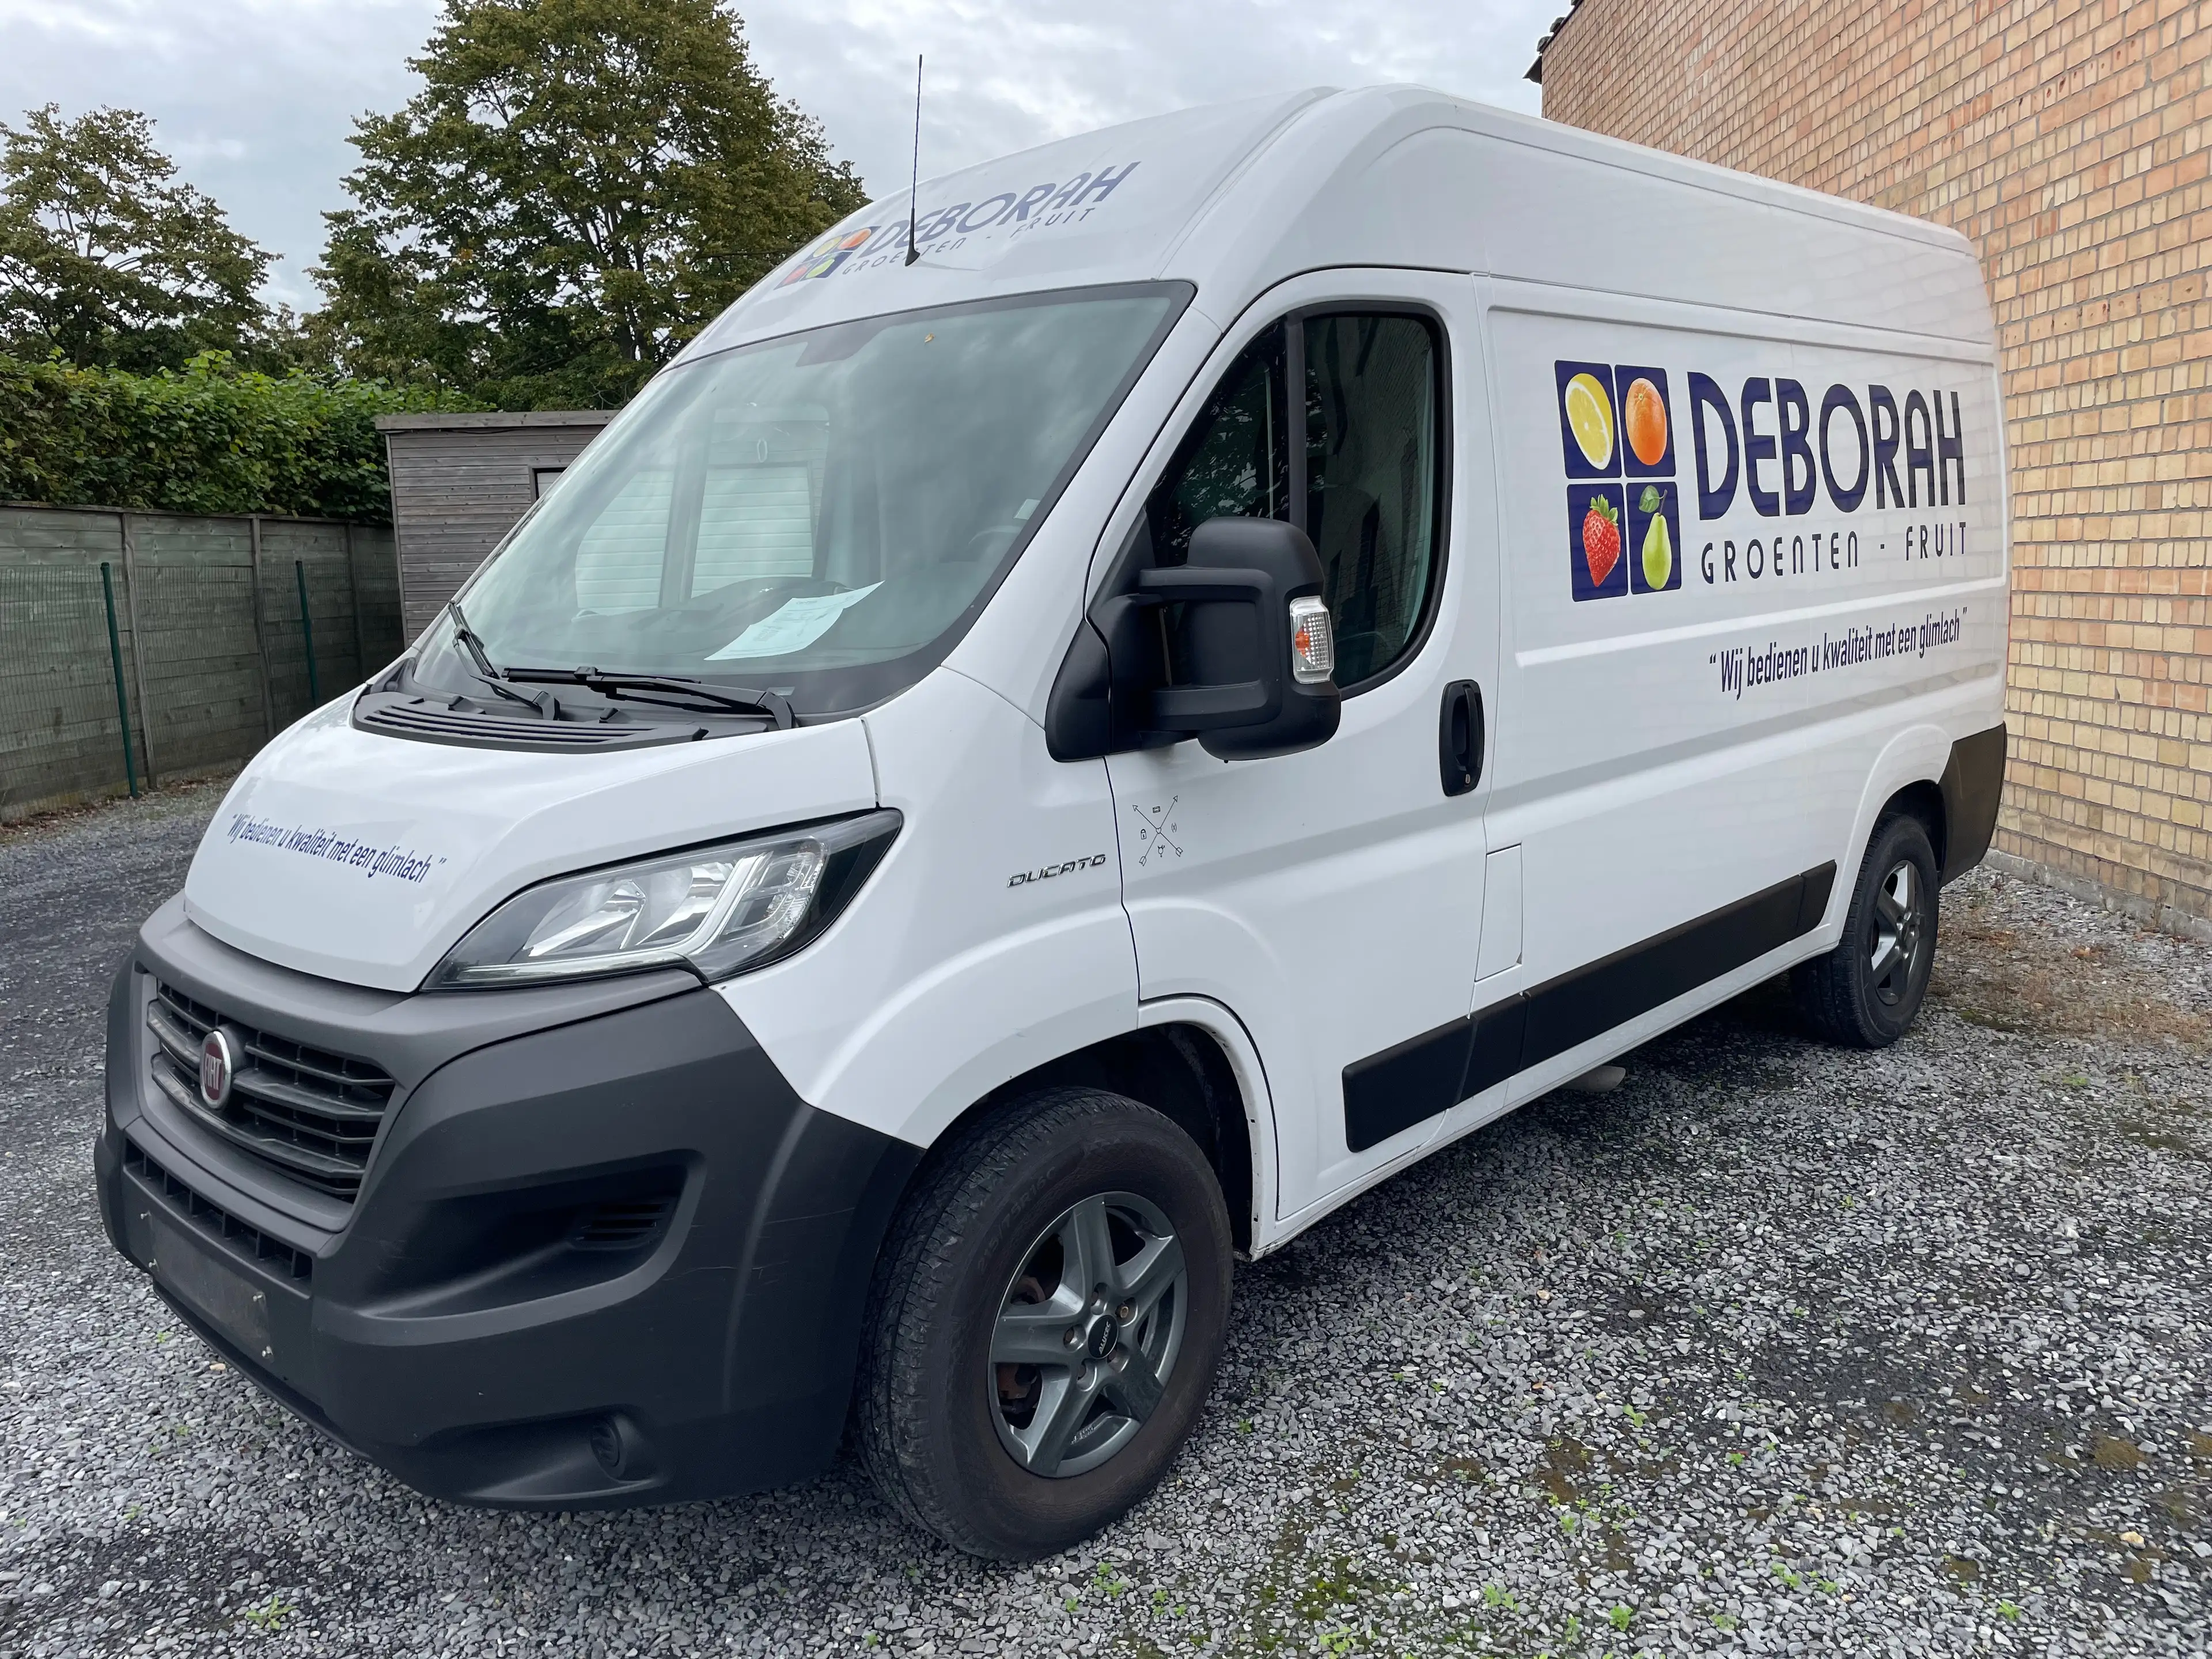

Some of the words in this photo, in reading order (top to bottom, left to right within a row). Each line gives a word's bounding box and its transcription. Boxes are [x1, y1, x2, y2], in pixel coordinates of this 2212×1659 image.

[843, 237, 967, 275] GROETEN
[1009, 207, 1096, 238] FRUIT
[858, 161, 1141, 259] DEBORAH
[1687, 372, 1966, 521] DEBORAH
[1701, 531, 1858, 584] GROENTEN
[1906, 522, 1966, 561] FRUIT
[1747, 642, 1808, 687] bedienen
[1811, 645, 1820, 673] u
[1823, 625, 1872, 671] kwaliteit
[1875, 623, 1895, 659] met
[1898, 626, 1916, 654] een
[239, 816, 284, 846] bedienen
[277, 830, 293, 847] u
[285, 824, 337, 858] kwaliteit
[326, 839, 359, 863] met
[349, 845, 377, 869] een
[1006, 854, 1106, 888] DUCATO
[204, 1053, 222, 1090] FIAT
